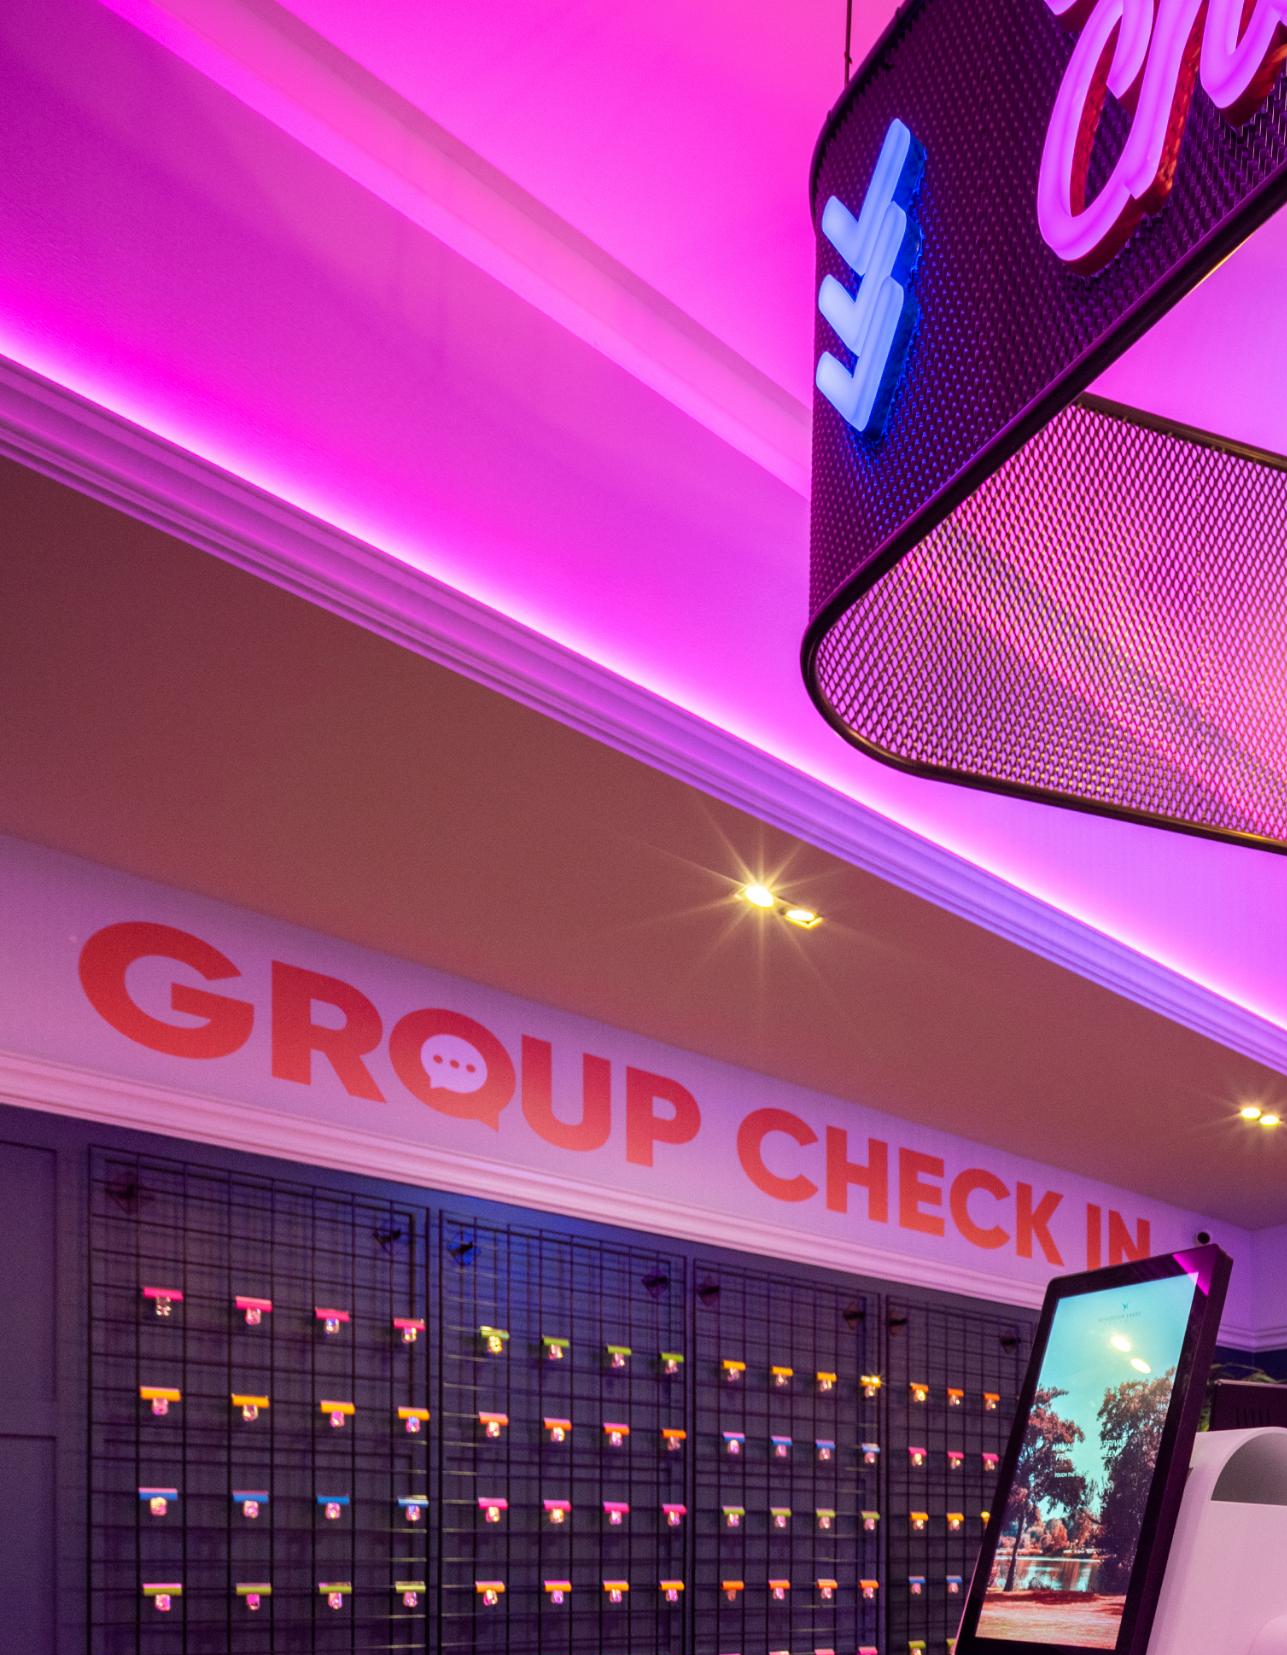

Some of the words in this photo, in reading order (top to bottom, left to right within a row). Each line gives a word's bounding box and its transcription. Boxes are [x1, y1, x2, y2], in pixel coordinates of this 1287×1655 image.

[77, 921, 703, 1167] GROUP
[737, 1107, 1064, 1267] CHECK
[1086, 1203, 1151, 1271] IN
